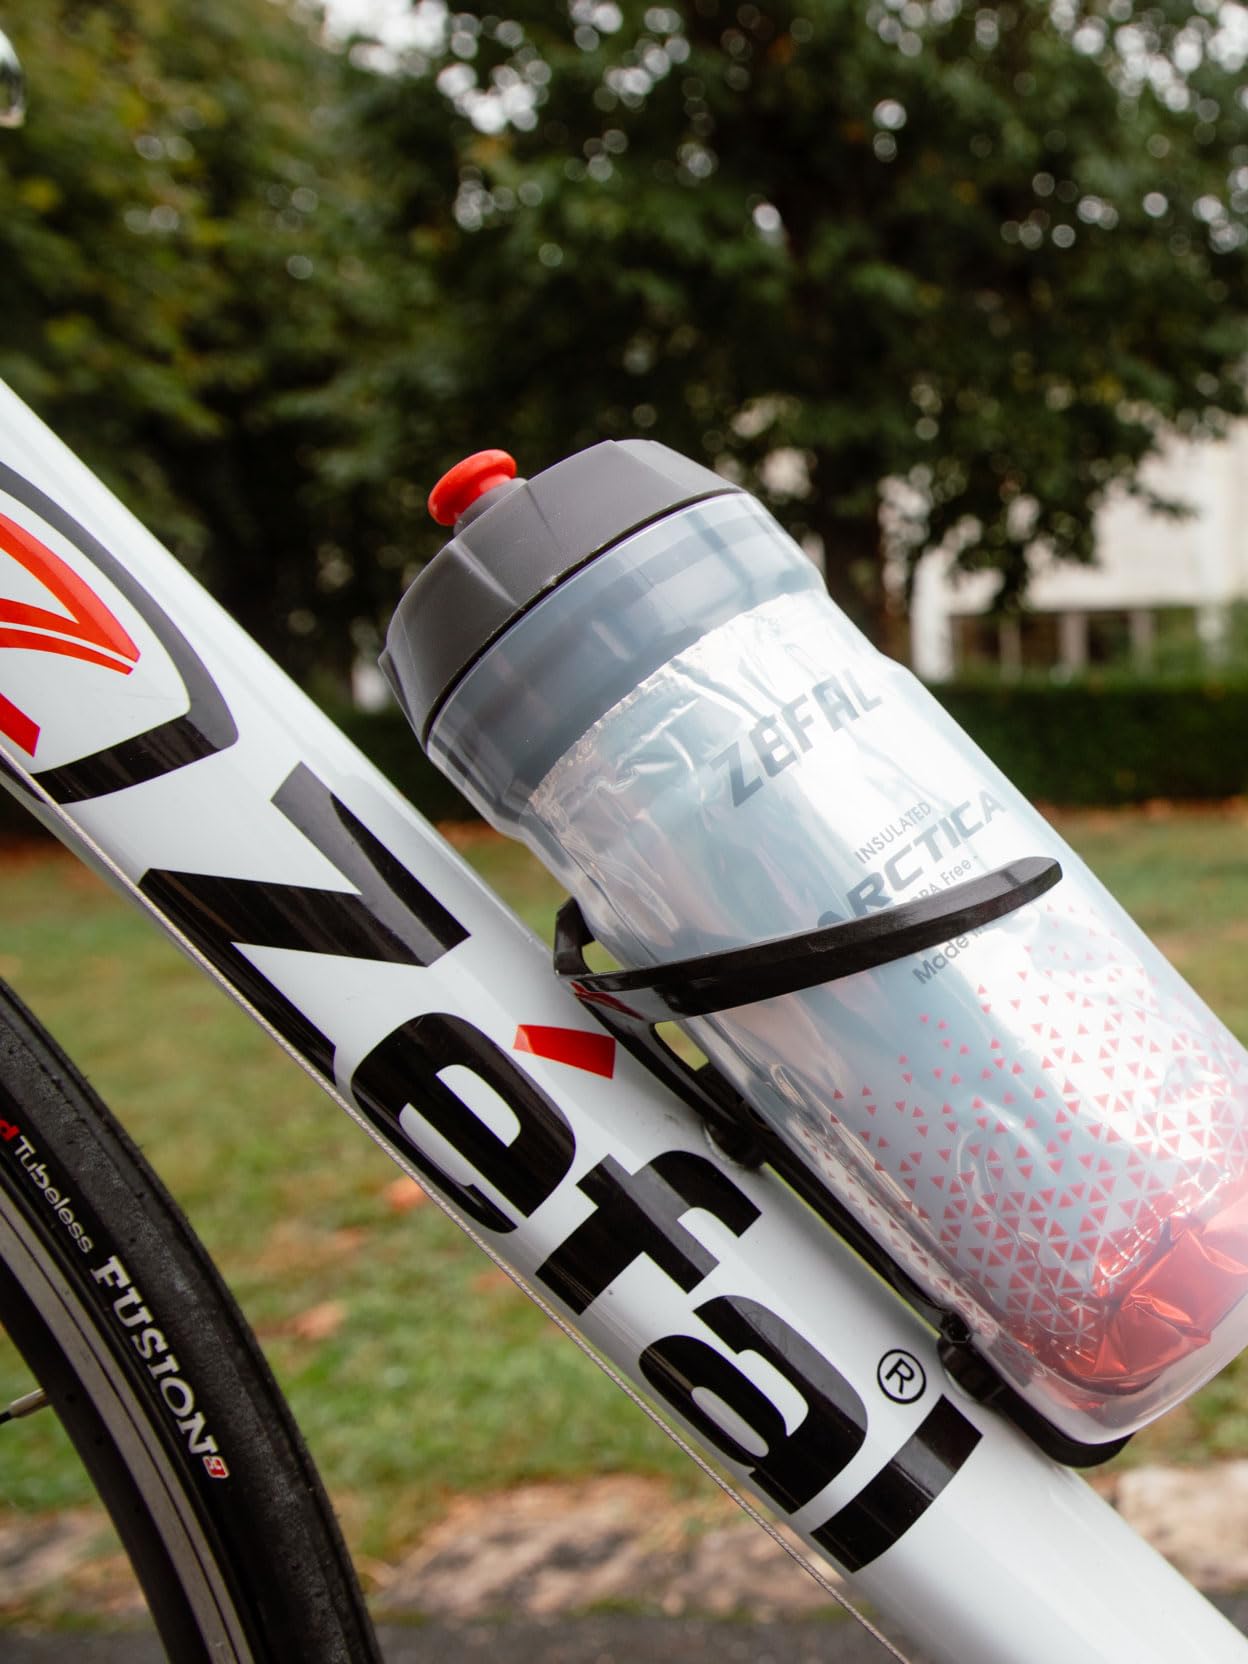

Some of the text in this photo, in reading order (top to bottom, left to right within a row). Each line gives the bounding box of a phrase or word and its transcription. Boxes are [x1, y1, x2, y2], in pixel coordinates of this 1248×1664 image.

[854, 801, 931, 864] INSULATED
[910, 859, 972, 901] PA Free
[912, 933, 969, 984] Made
[15, 1135, 94, 1253] Tubeless
